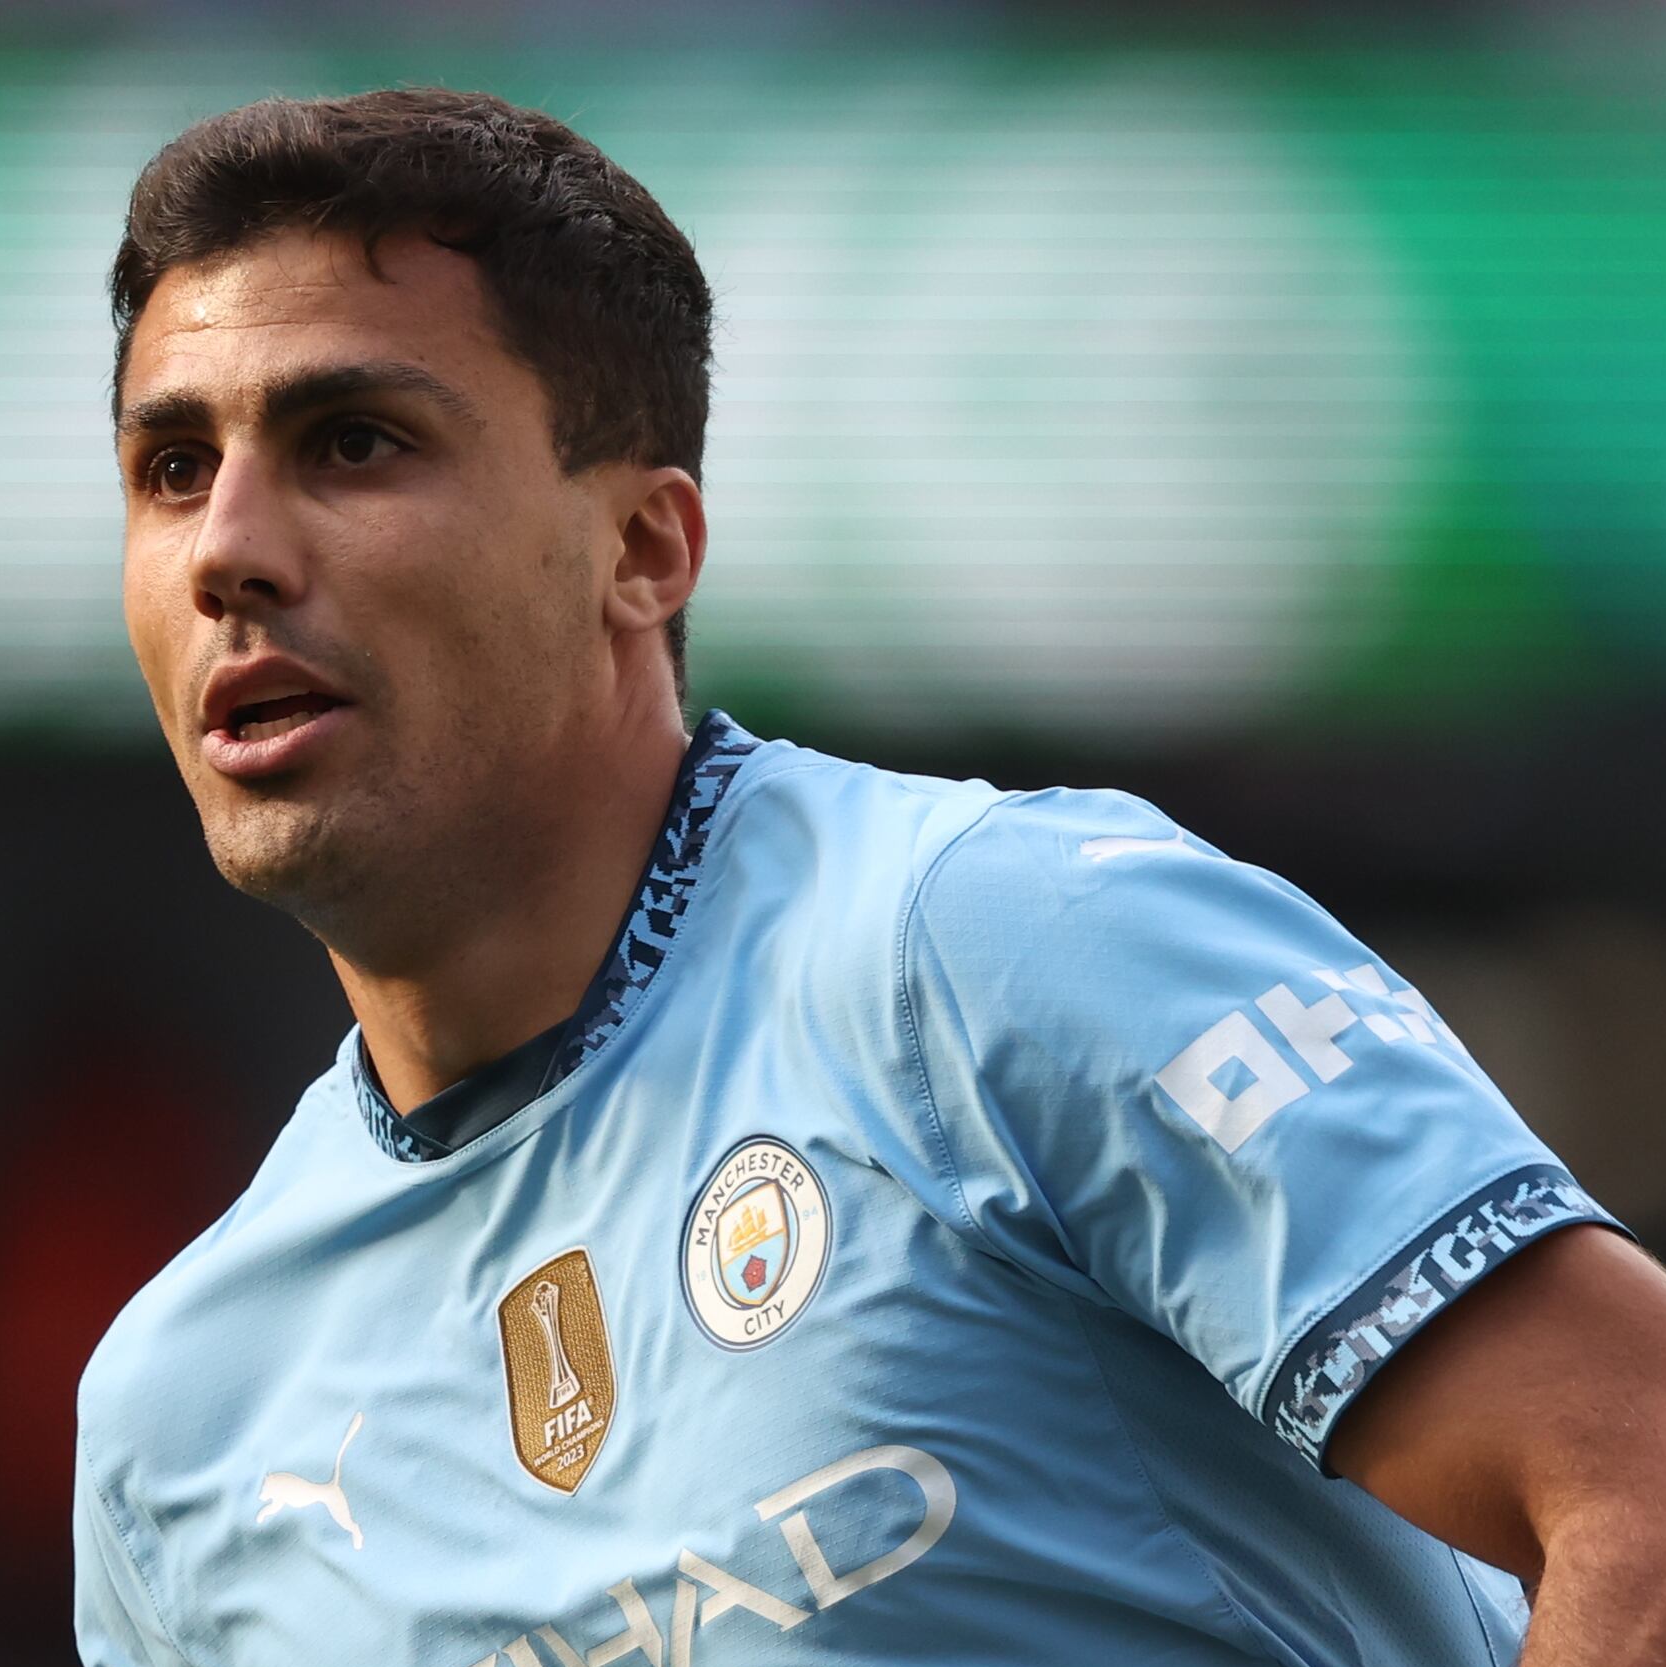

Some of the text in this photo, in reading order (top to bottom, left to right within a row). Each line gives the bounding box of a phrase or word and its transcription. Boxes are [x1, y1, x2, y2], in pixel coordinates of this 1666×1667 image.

[695, 1152, 805, 1246] MANCHESTER
[744, 1300, 785, 1336] CITY
[533, 1418, 605, 1467] WORLD CHAMPIONS
[544, 1400, 593, 1448] FIFA
[556, 1443, 585, 1472] 2023
